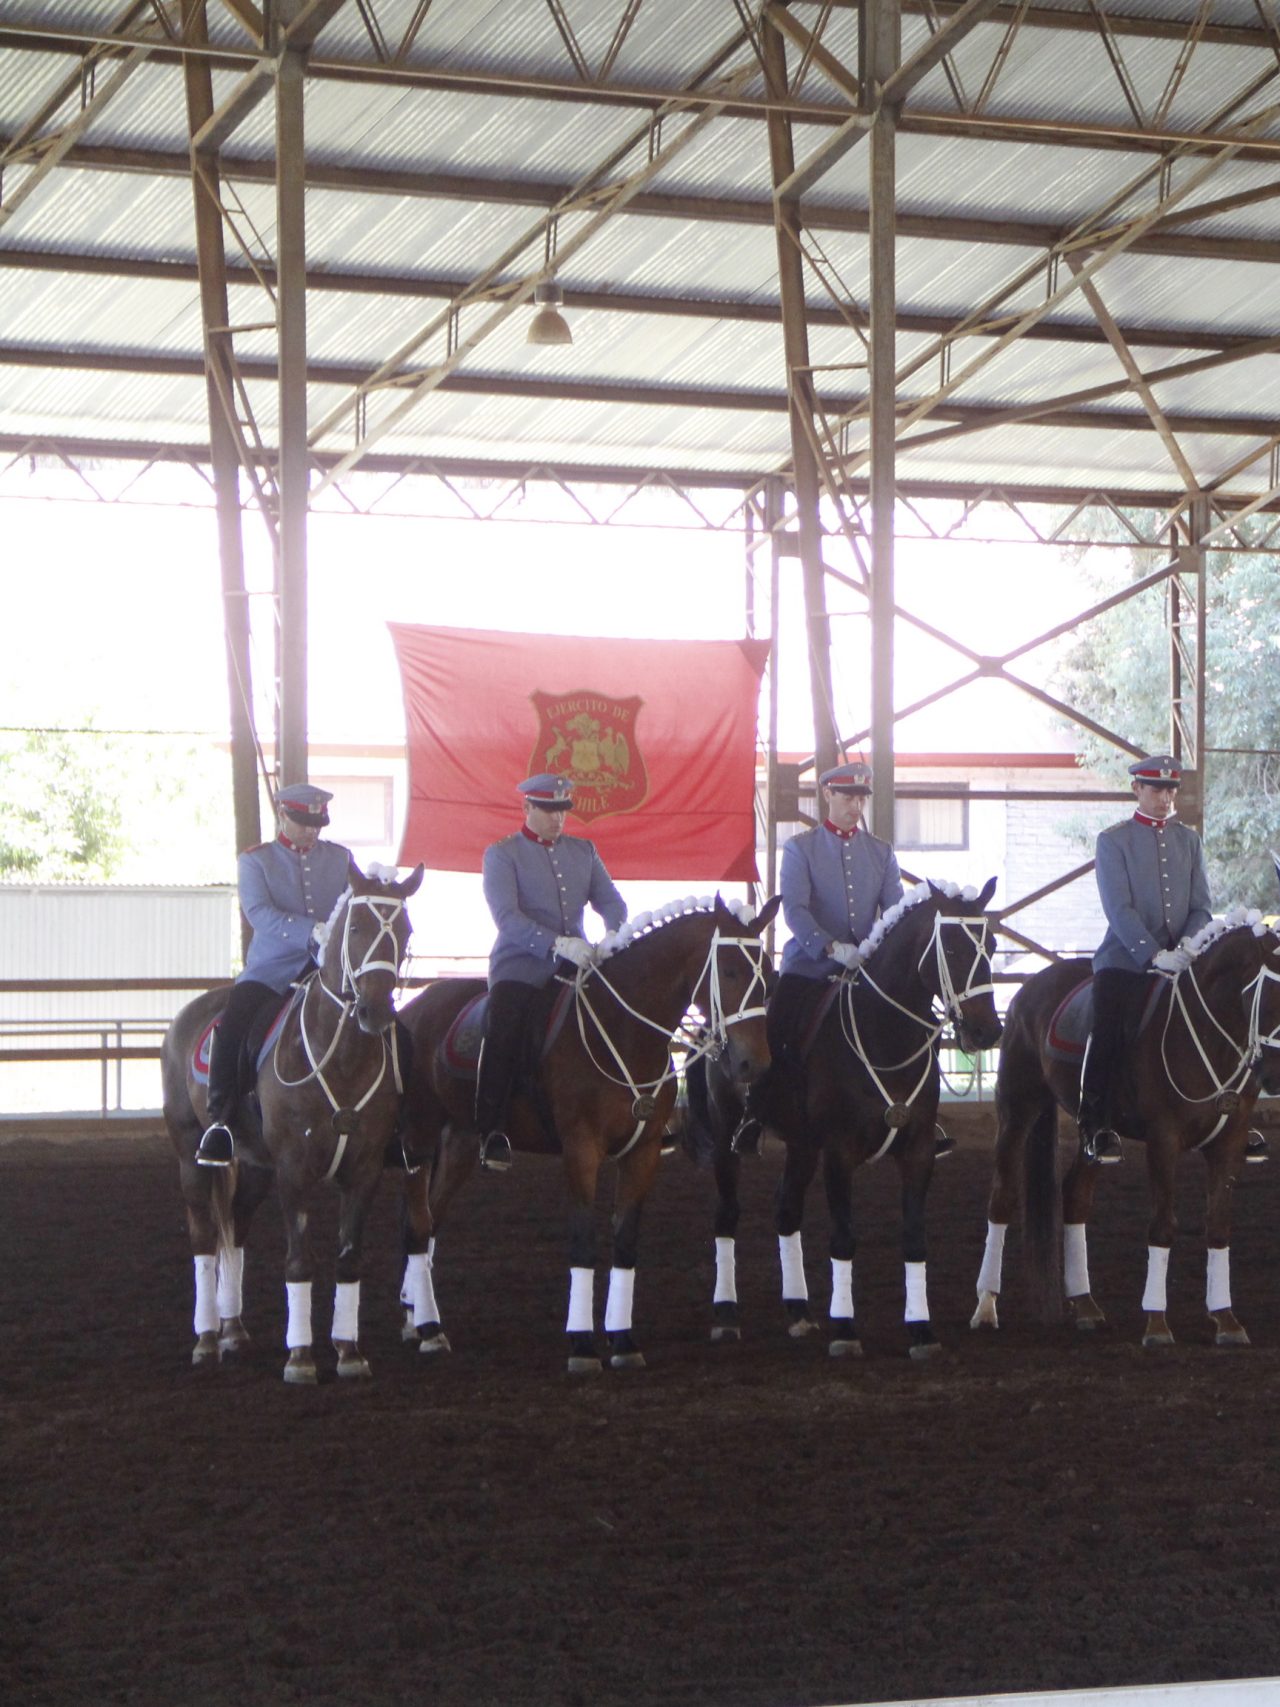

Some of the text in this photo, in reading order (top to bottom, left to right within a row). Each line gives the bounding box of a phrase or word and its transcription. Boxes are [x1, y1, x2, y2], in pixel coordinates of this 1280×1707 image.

[546, 699, 630, 721] EJERCITO DE
[571, 794, 610, 812] HILE
